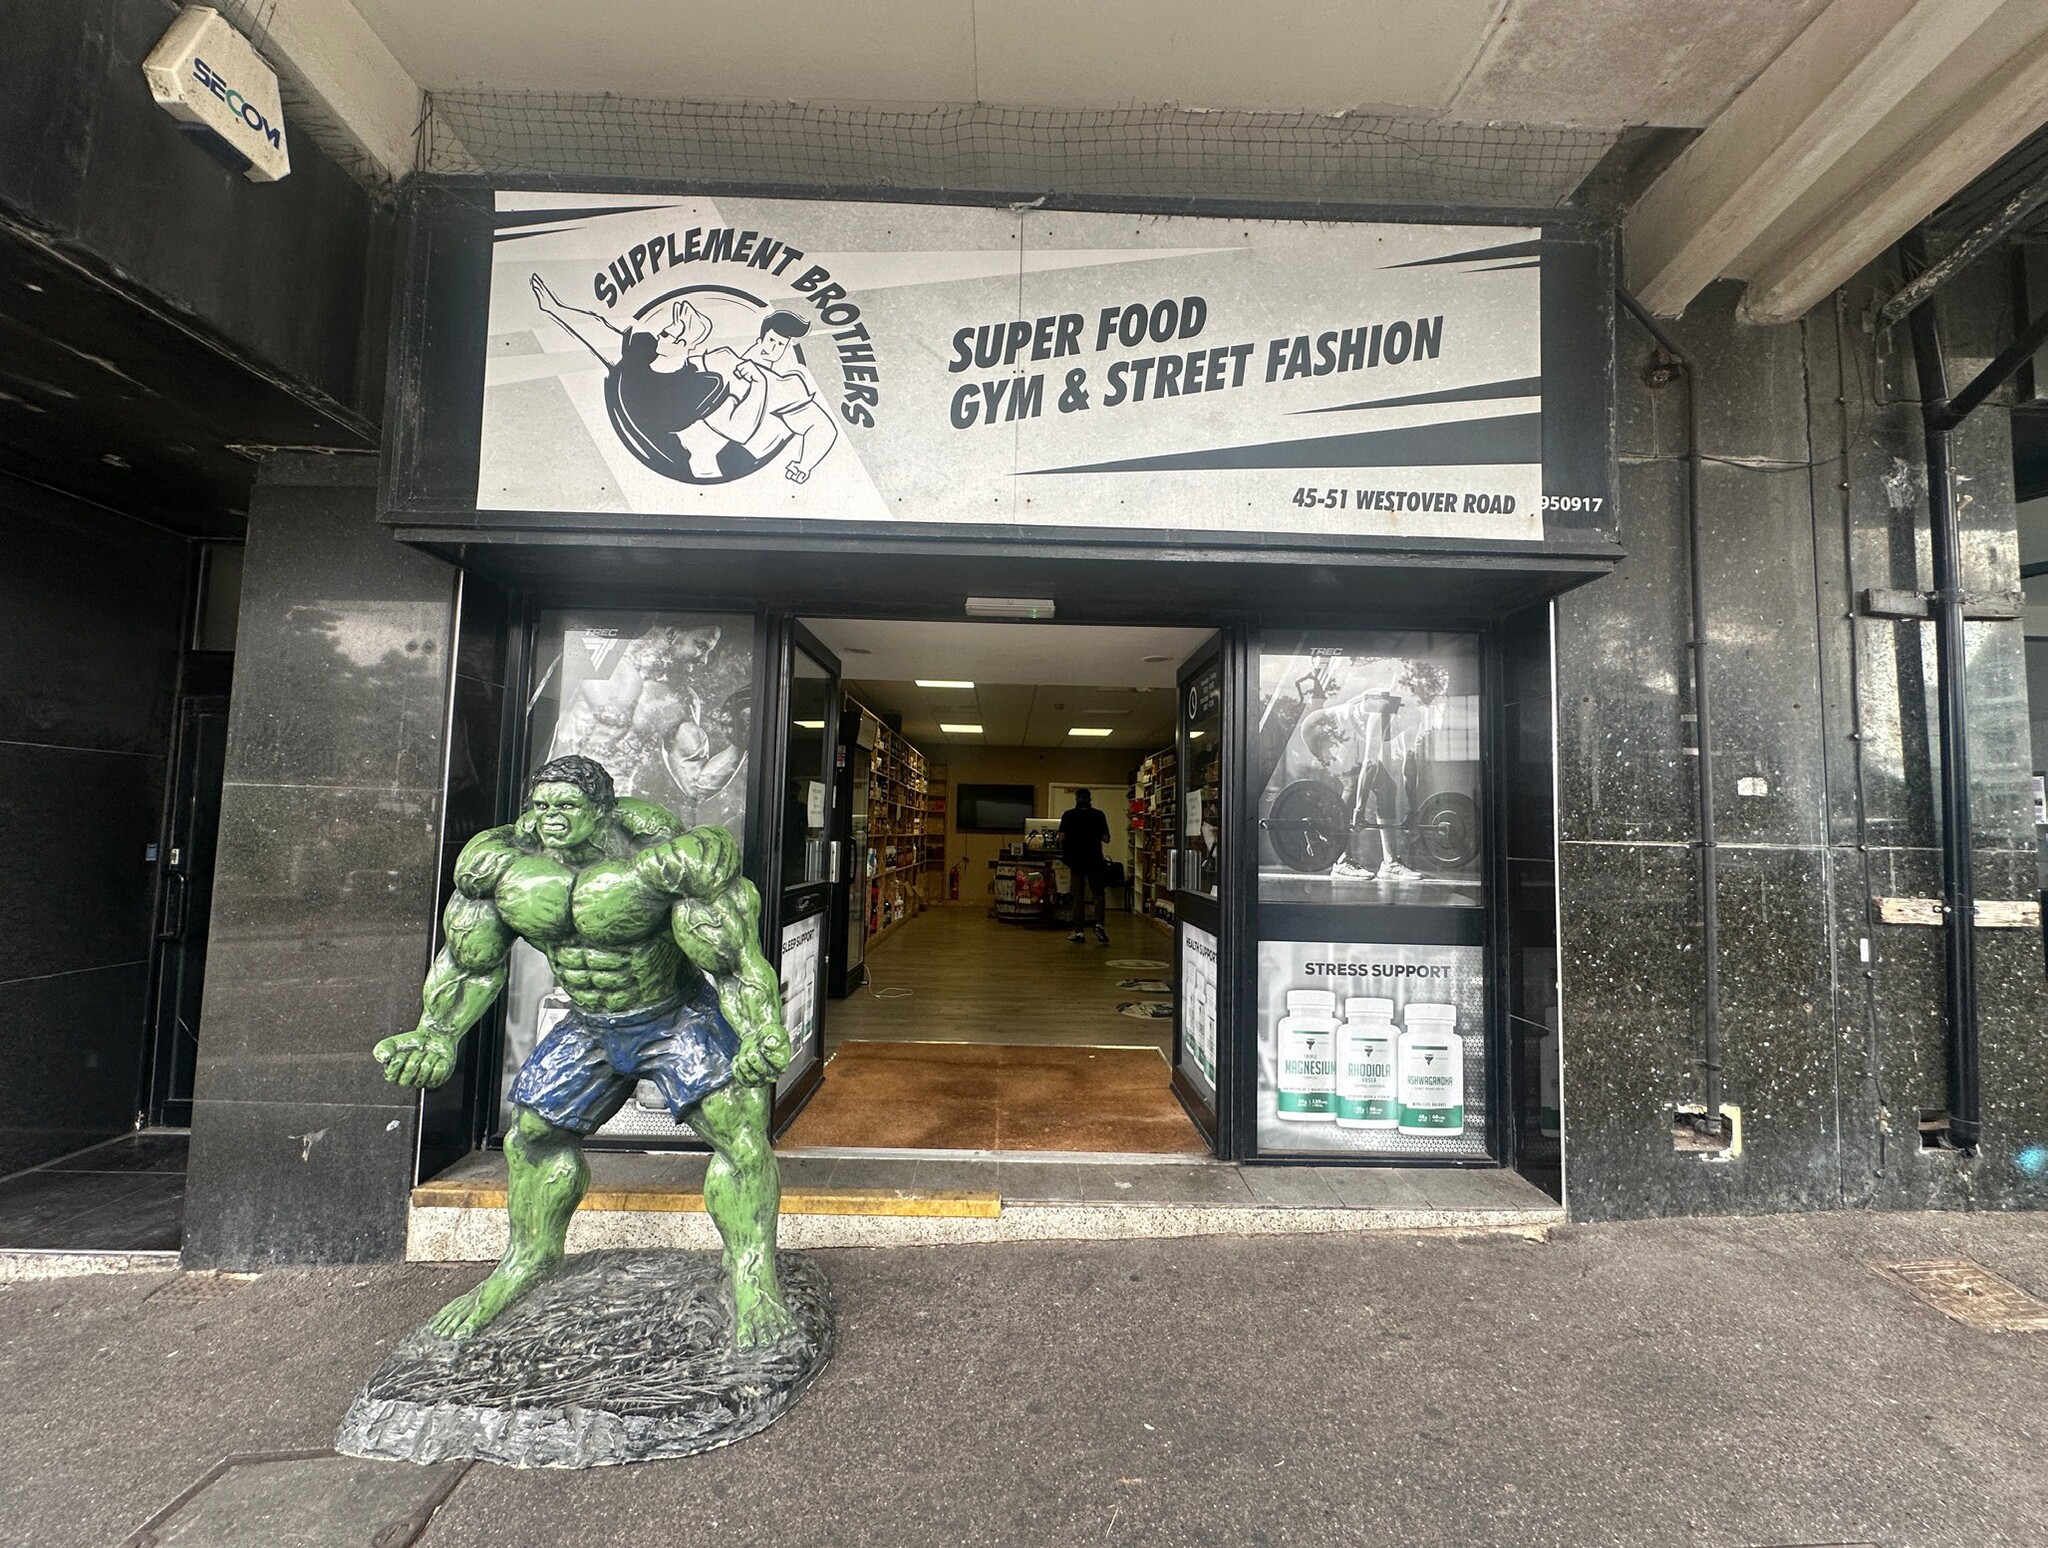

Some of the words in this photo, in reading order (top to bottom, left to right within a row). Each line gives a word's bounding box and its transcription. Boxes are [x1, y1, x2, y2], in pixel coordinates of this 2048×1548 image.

[193, 58, 280, 150] SECOM
[594, 227, 805, 309] SUPPLEMENT
[791, 265, 881, 429] BROTHERS
[949, 313, 1085, 373] SUPER
[1096, 295, 1208, 353] FOOD
[949, 369, 1042, 431] GYM
[1057, 366, 1090, 414] &
[1103, 343, 1256, 407] STREET
[1265, 315, 1445, 383] FASHION
[1292, 487, 1348, 511] 45-51
[1355, 489, 1458, 514] WESTOVER
[1463, 491, 1516, 515] ROAD
[1541, 495, 1604, 512] 950917
[585, 628, 619, 637] TREC
[1310, 647, 1344, 656] TREC
[796, 928, 815, 948] SUPPORT
[1186, 937, 1200, 954] HEALTH
[1200, 944, 1217, 962] SUPPORT
[1304, 962, 1368, 977] STRESS
[1371, 964, 1451, 979] SUPPORT
[1348, 1062, 1391, 1078] RHODIOLA
